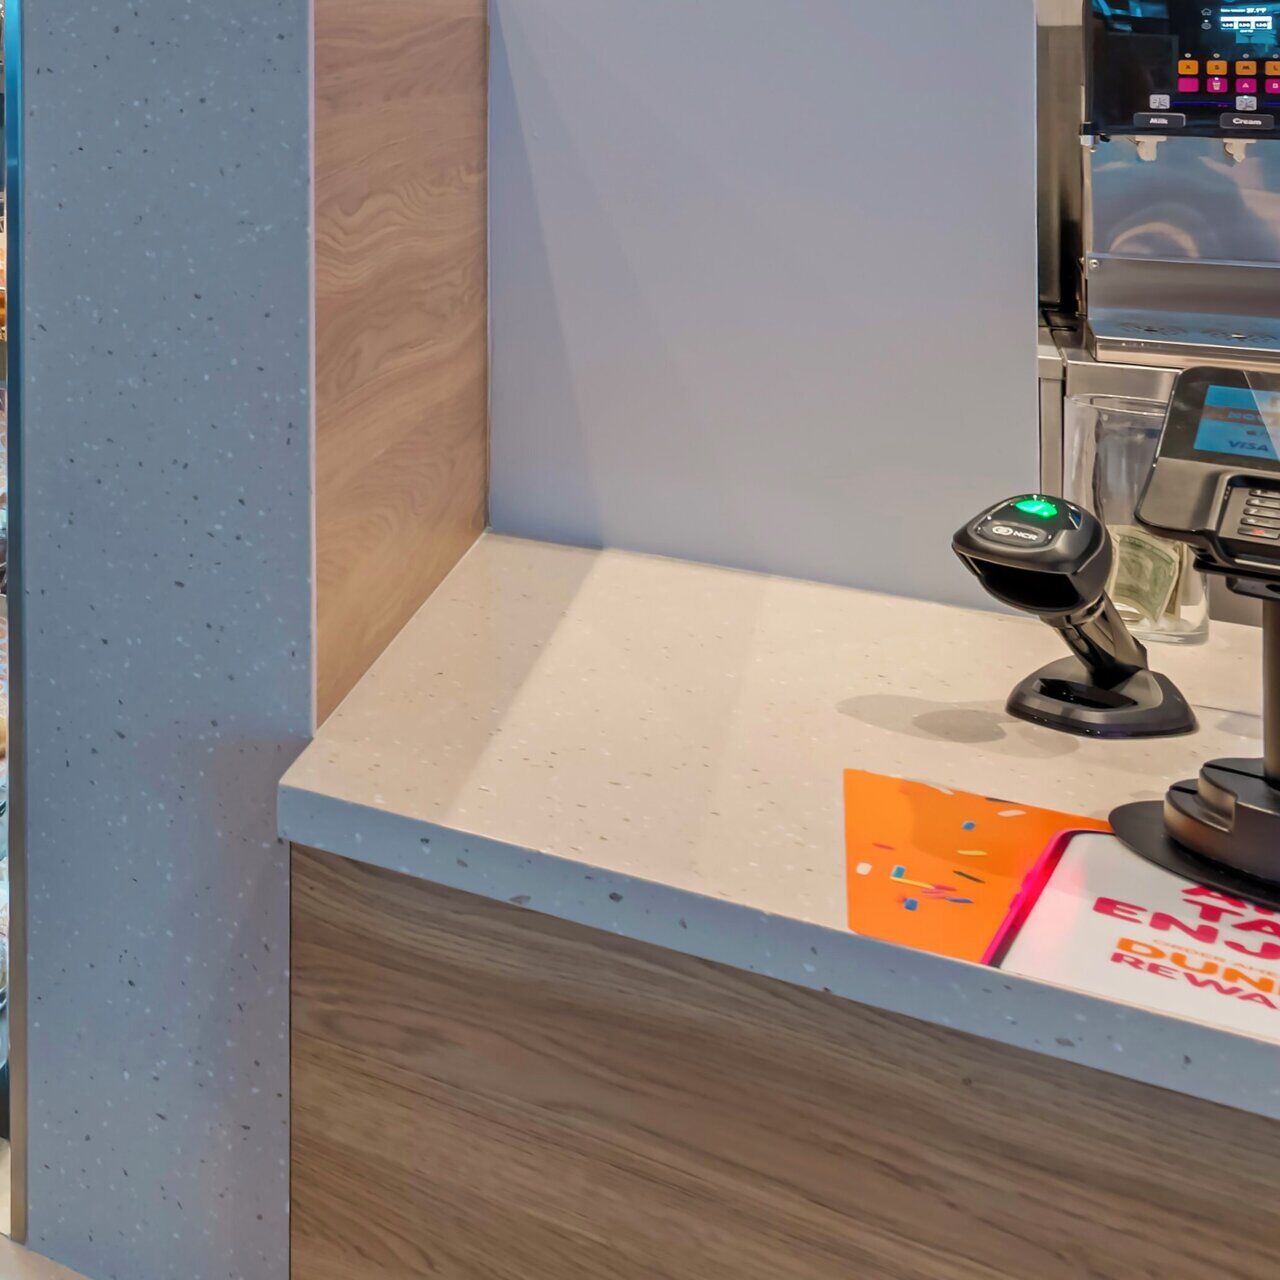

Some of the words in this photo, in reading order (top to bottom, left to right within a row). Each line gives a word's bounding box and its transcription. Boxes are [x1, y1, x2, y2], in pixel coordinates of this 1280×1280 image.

[1232, 117, 1262, 126] Cream
[1228, 440, 1269, 452] VISA
[1013, 531, 1038, 540] NCR
[1117, 937, 1280, 995] DUN
